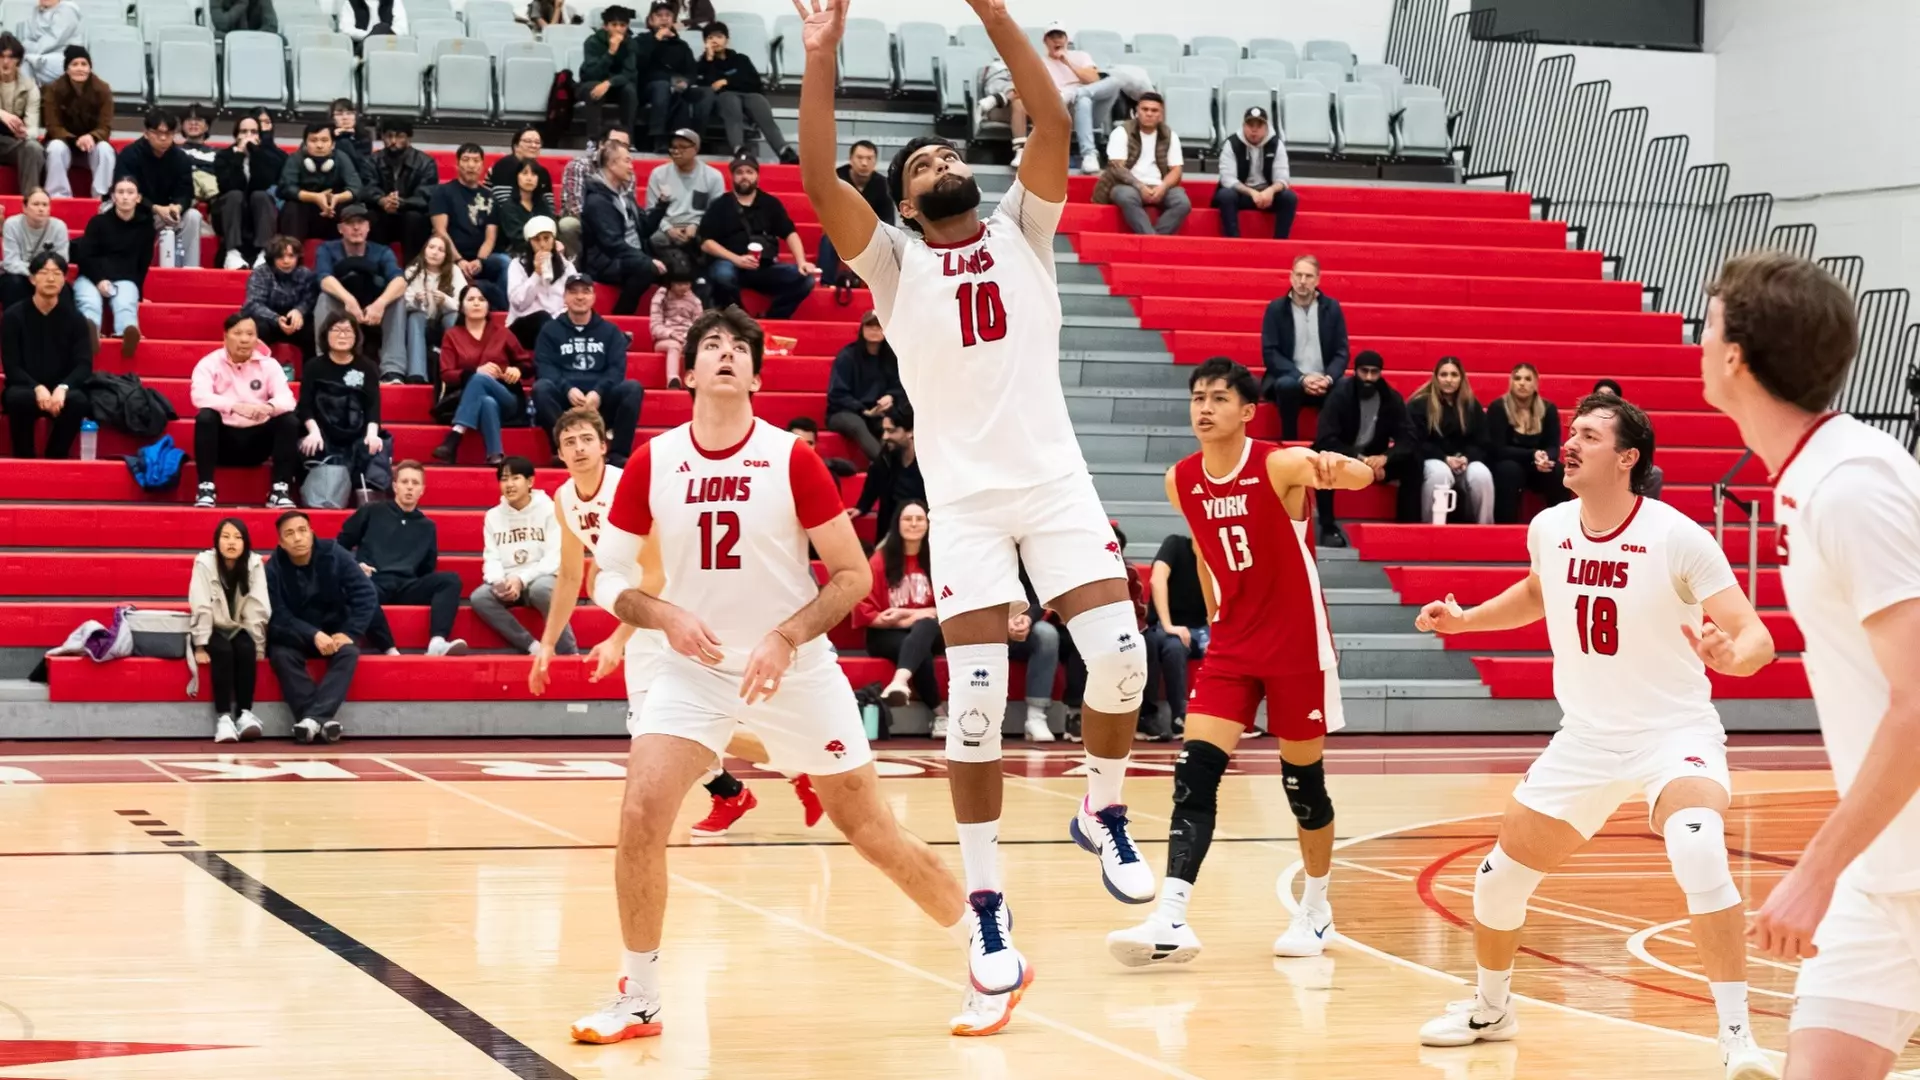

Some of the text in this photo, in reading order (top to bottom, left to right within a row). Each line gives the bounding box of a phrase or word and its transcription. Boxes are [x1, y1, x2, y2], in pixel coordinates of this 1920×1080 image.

[955, 281, 1007, 347] 10
[684, 476, 751, 504] LIONS
[1202, 494, 1248, 520] YORK
[697, 510, 742, 570] 12
[1218, 525, 1254, 572] 13
[1620, 543, 1647, 554] OUA
[1567, 557, 1629, 589] LIONS
[1575, 594, 1619, 656] 18
